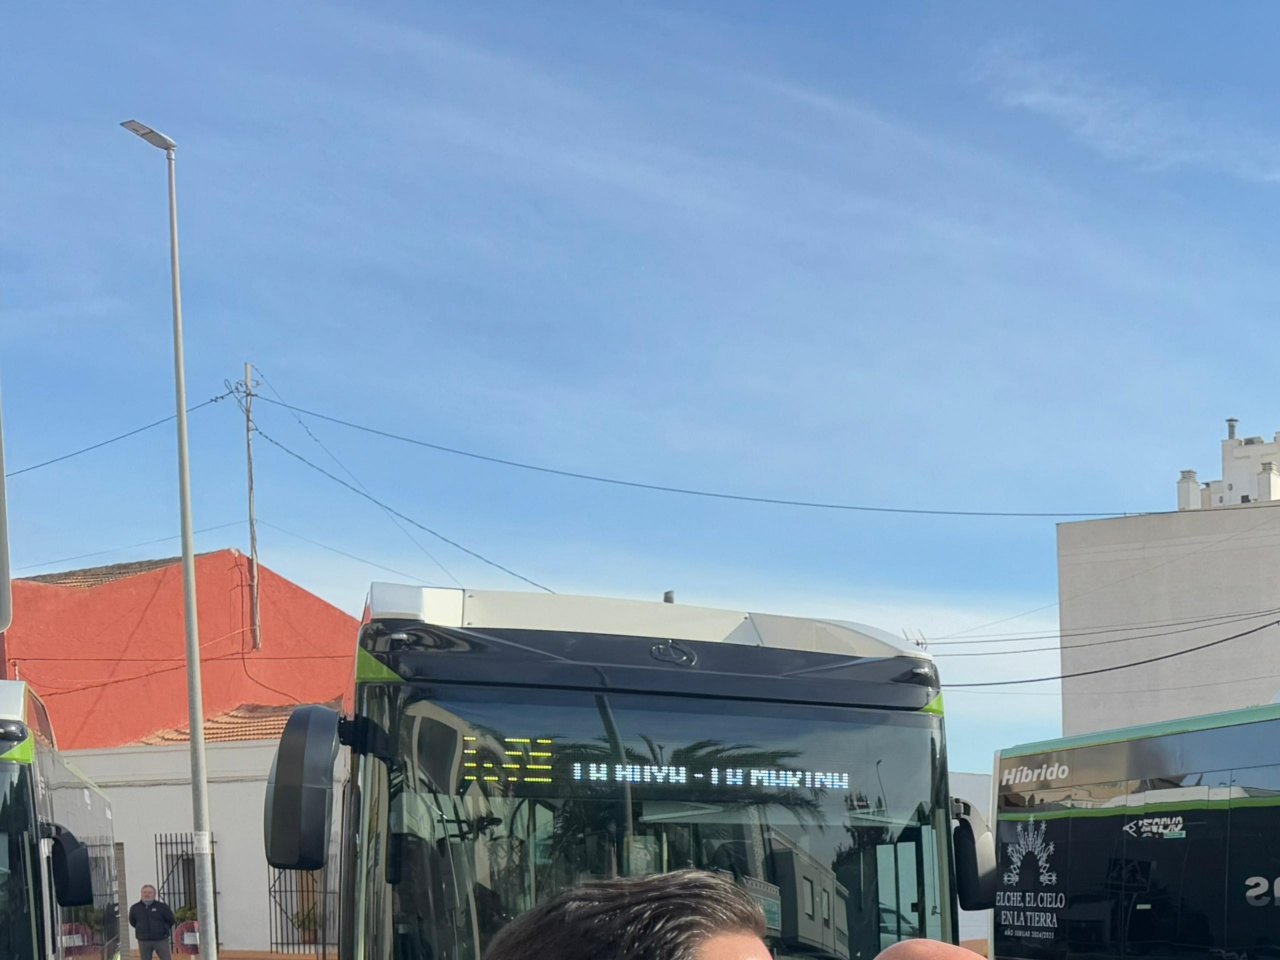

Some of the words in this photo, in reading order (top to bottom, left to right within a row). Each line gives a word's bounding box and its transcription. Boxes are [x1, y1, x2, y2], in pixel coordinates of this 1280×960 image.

[1001, 762, 1069, 786] Híbrido
[995, 891, 1024, 908] ELCHE,
[1025, 892, 1037, 907] EL
[1037, 892, 1066, 909] CIELO
[1001, 910, 1013, 925] EN
[1014, 911, 1025, 926] LA
[1025, 911, 1058, 928] TIERRA
